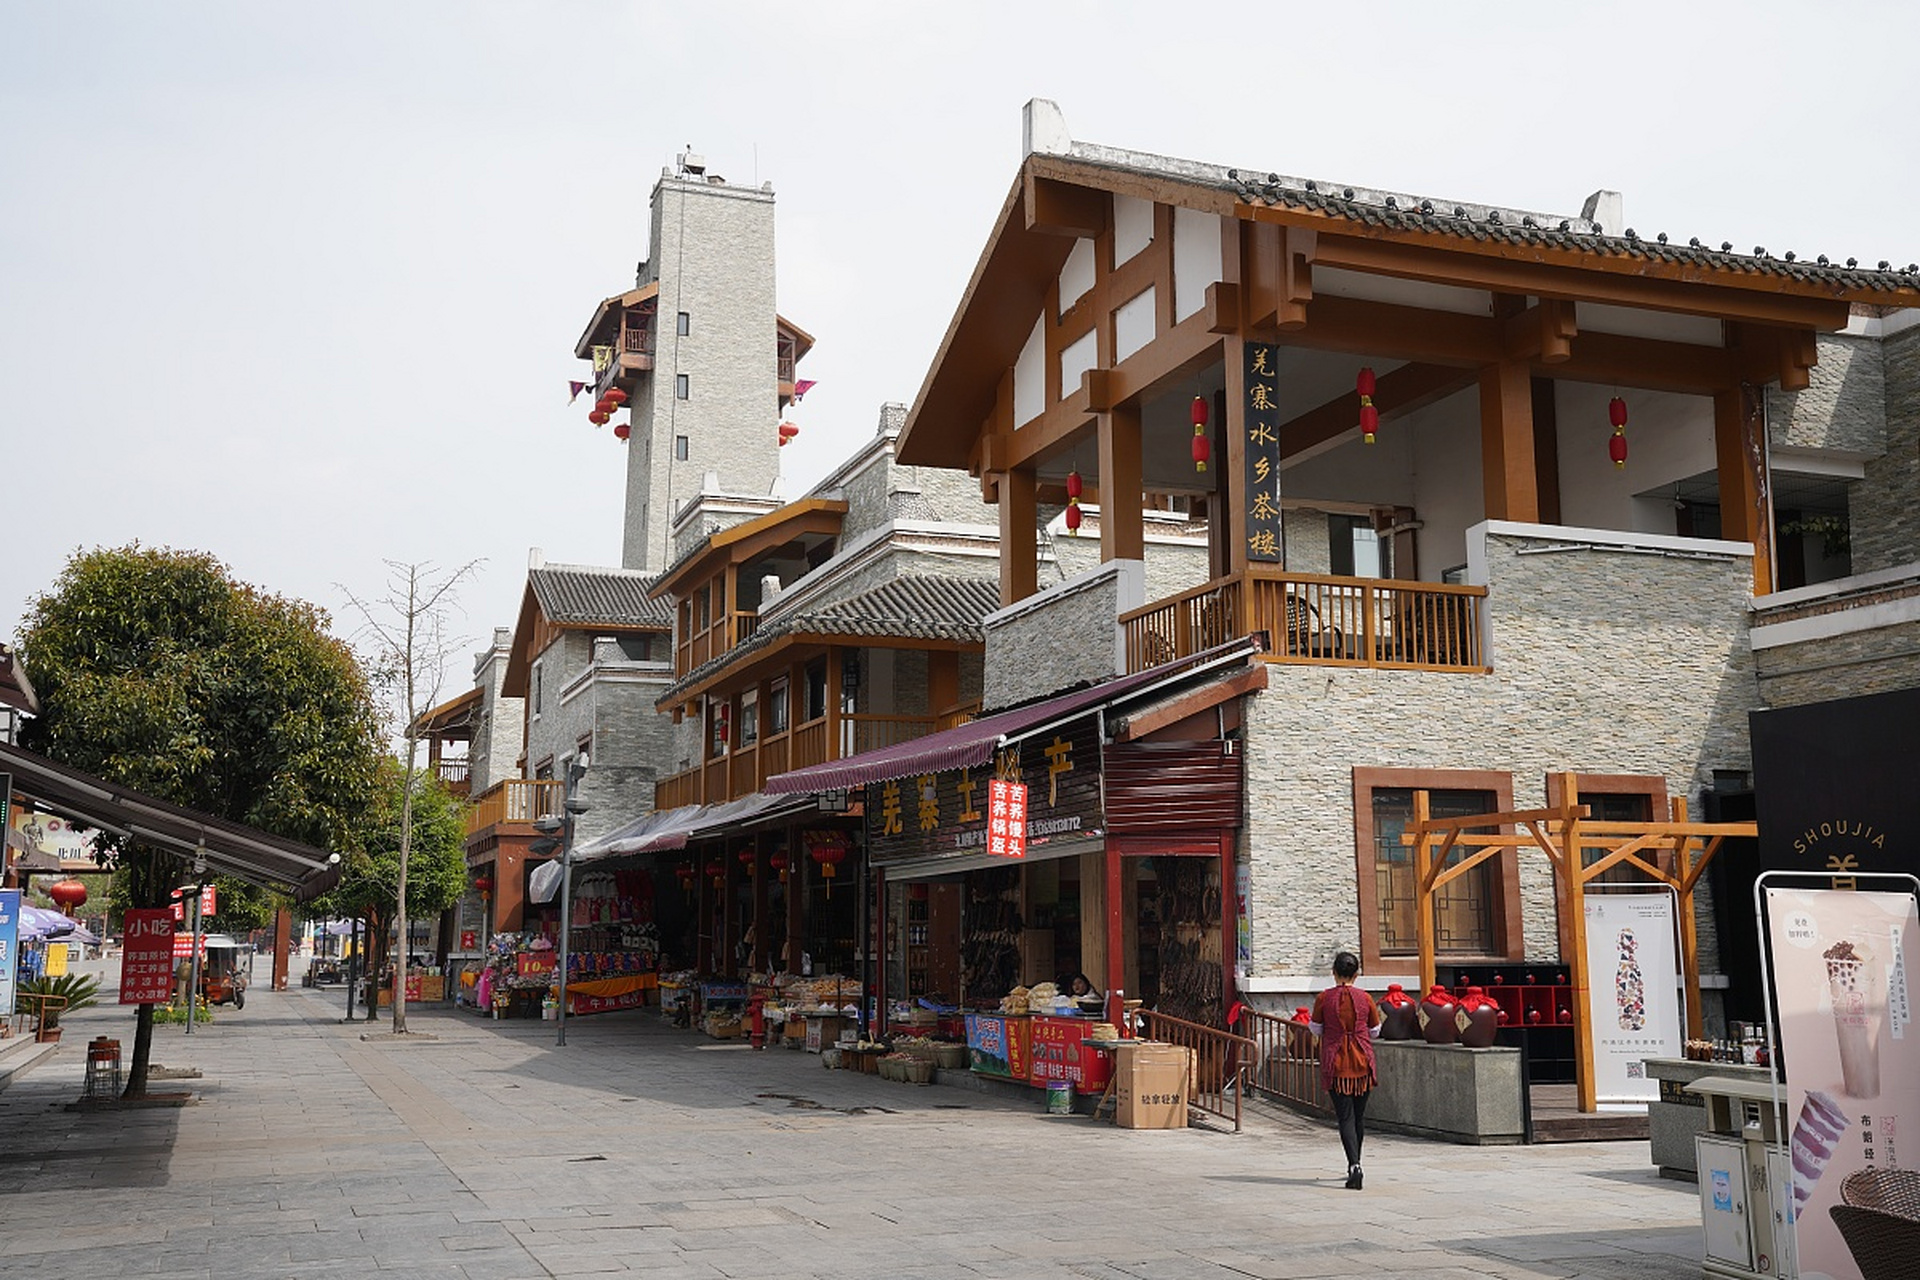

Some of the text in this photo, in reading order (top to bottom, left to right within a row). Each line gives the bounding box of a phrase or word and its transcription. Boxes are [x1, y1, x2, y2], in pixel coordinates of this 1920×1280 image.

[1247, 348, 1280, 557] 羌寨水乡茶楼
[991, 783, 1007, 854] 苦荞锅盔
[1008, 785, 1023, 856] 苦荞馒头
[1793, 820, 1885, 854] SHOUJIA
[129, 919, 171, 938] 小吃
[1141, 1093, 1180, 1105] 轻拿轻放
